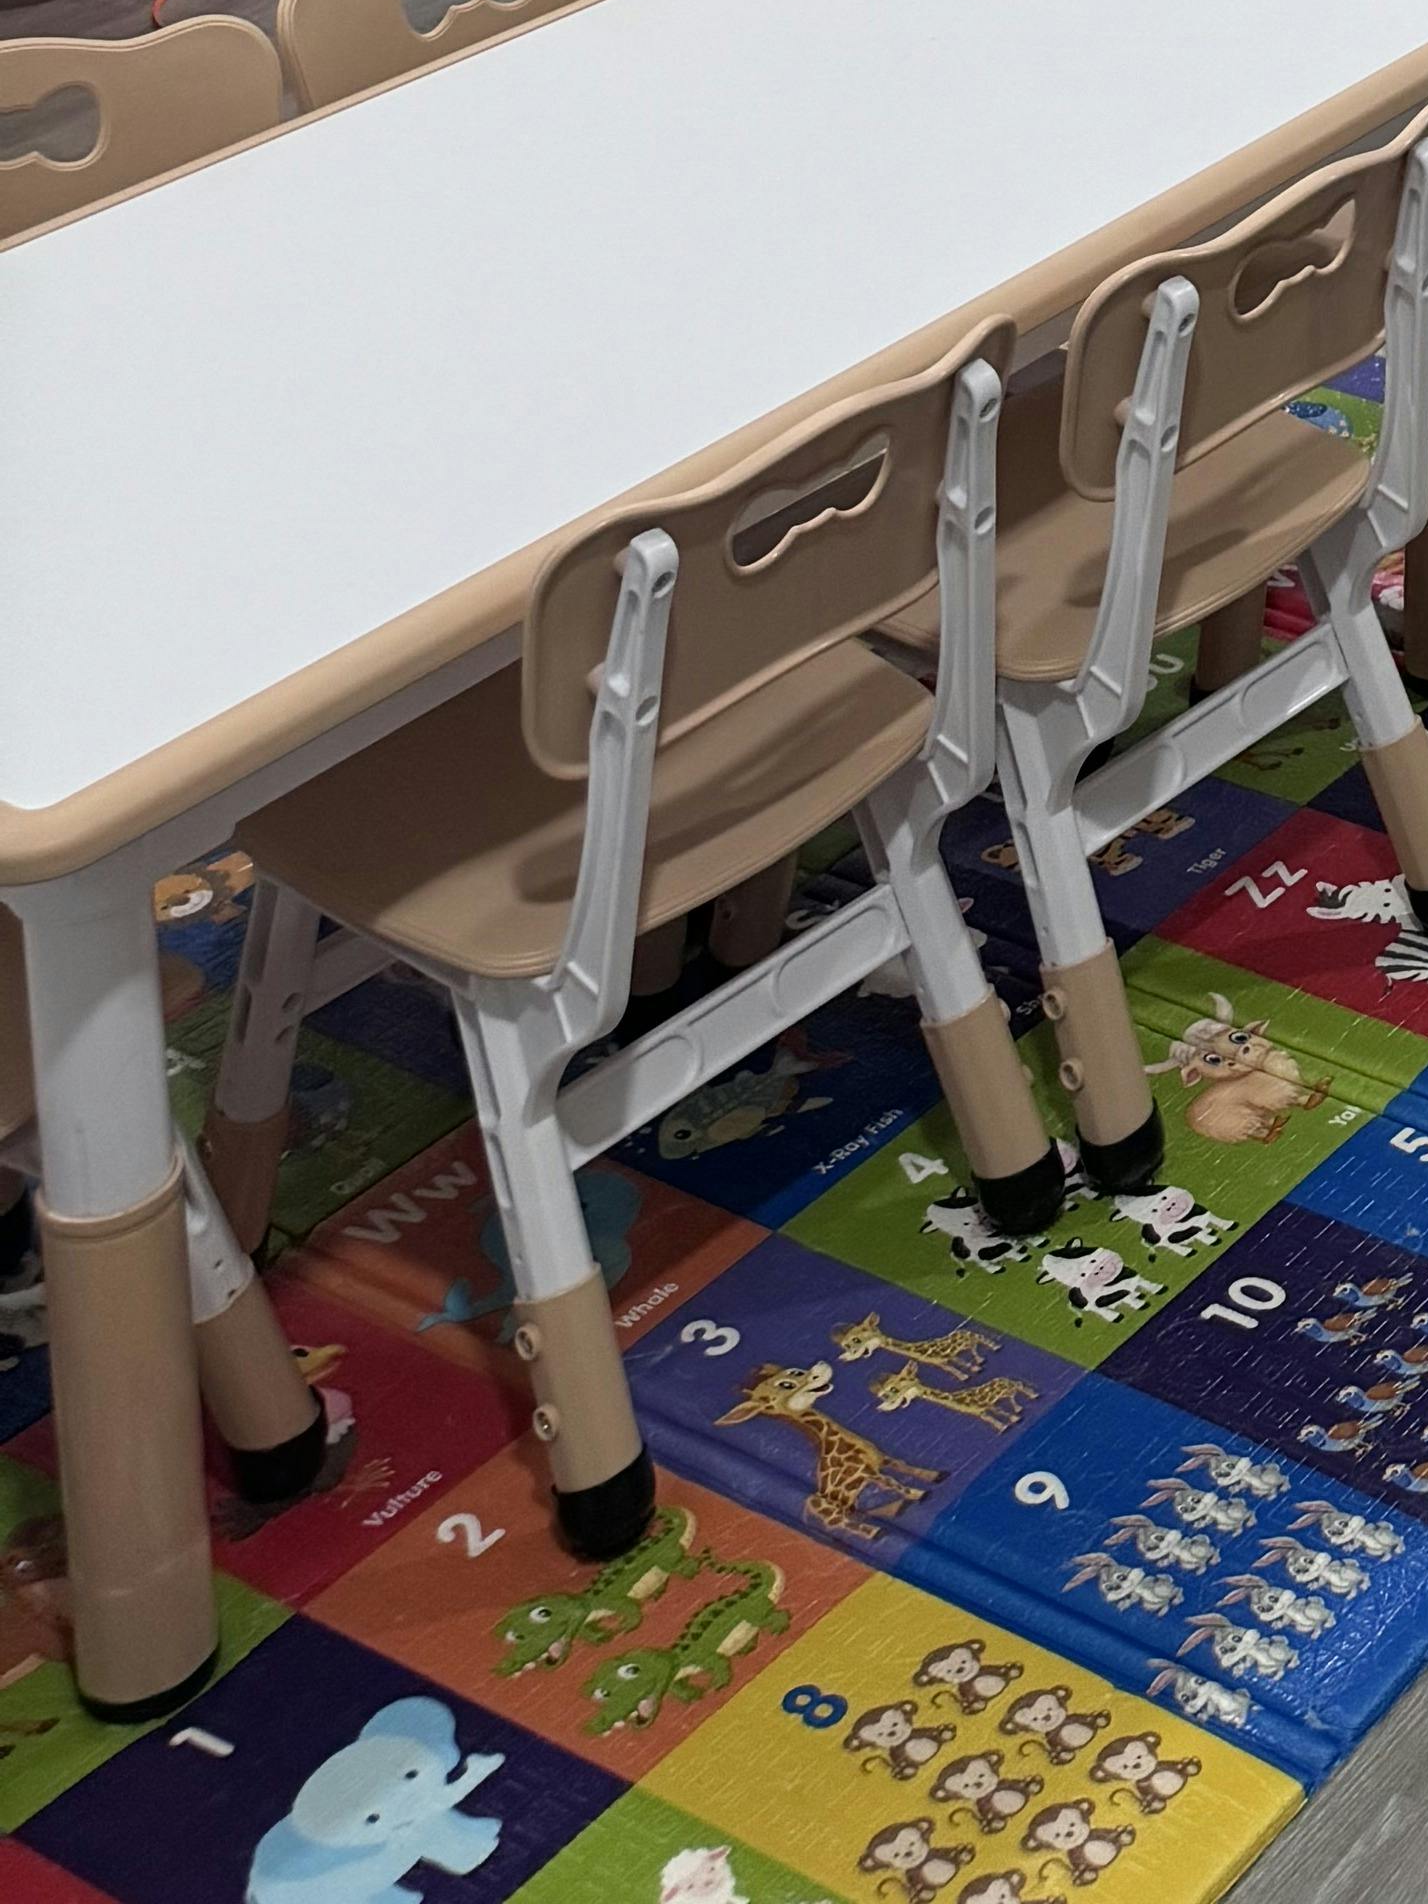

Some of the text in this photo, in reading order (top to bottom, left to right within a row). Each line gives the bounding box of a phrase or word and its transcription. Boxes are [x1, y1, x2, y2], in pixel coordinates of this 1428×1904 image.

[1186, 847, 1228, 876] Tiger
[1223, 860, 1309, 909] Zz
[812, 1108, 905, 1175] X-Ray Fish
[898, 1152, 950, 1185] 4
[341, 1159, 478, 1244] Ww
[613, 1279, 680, 1330] Whale
[1200, 1275, 1287, 1330] 10
[680, 1318, 742, 1358] 3
[361, 1469, 444, 1527] Vulture
[1013, 1469, 1072, 1512] 9
[435, 1511, 507, 1558] 2
[782, 1683, 848, 1730] 8
[167, 1723, 235, 1761] 1
